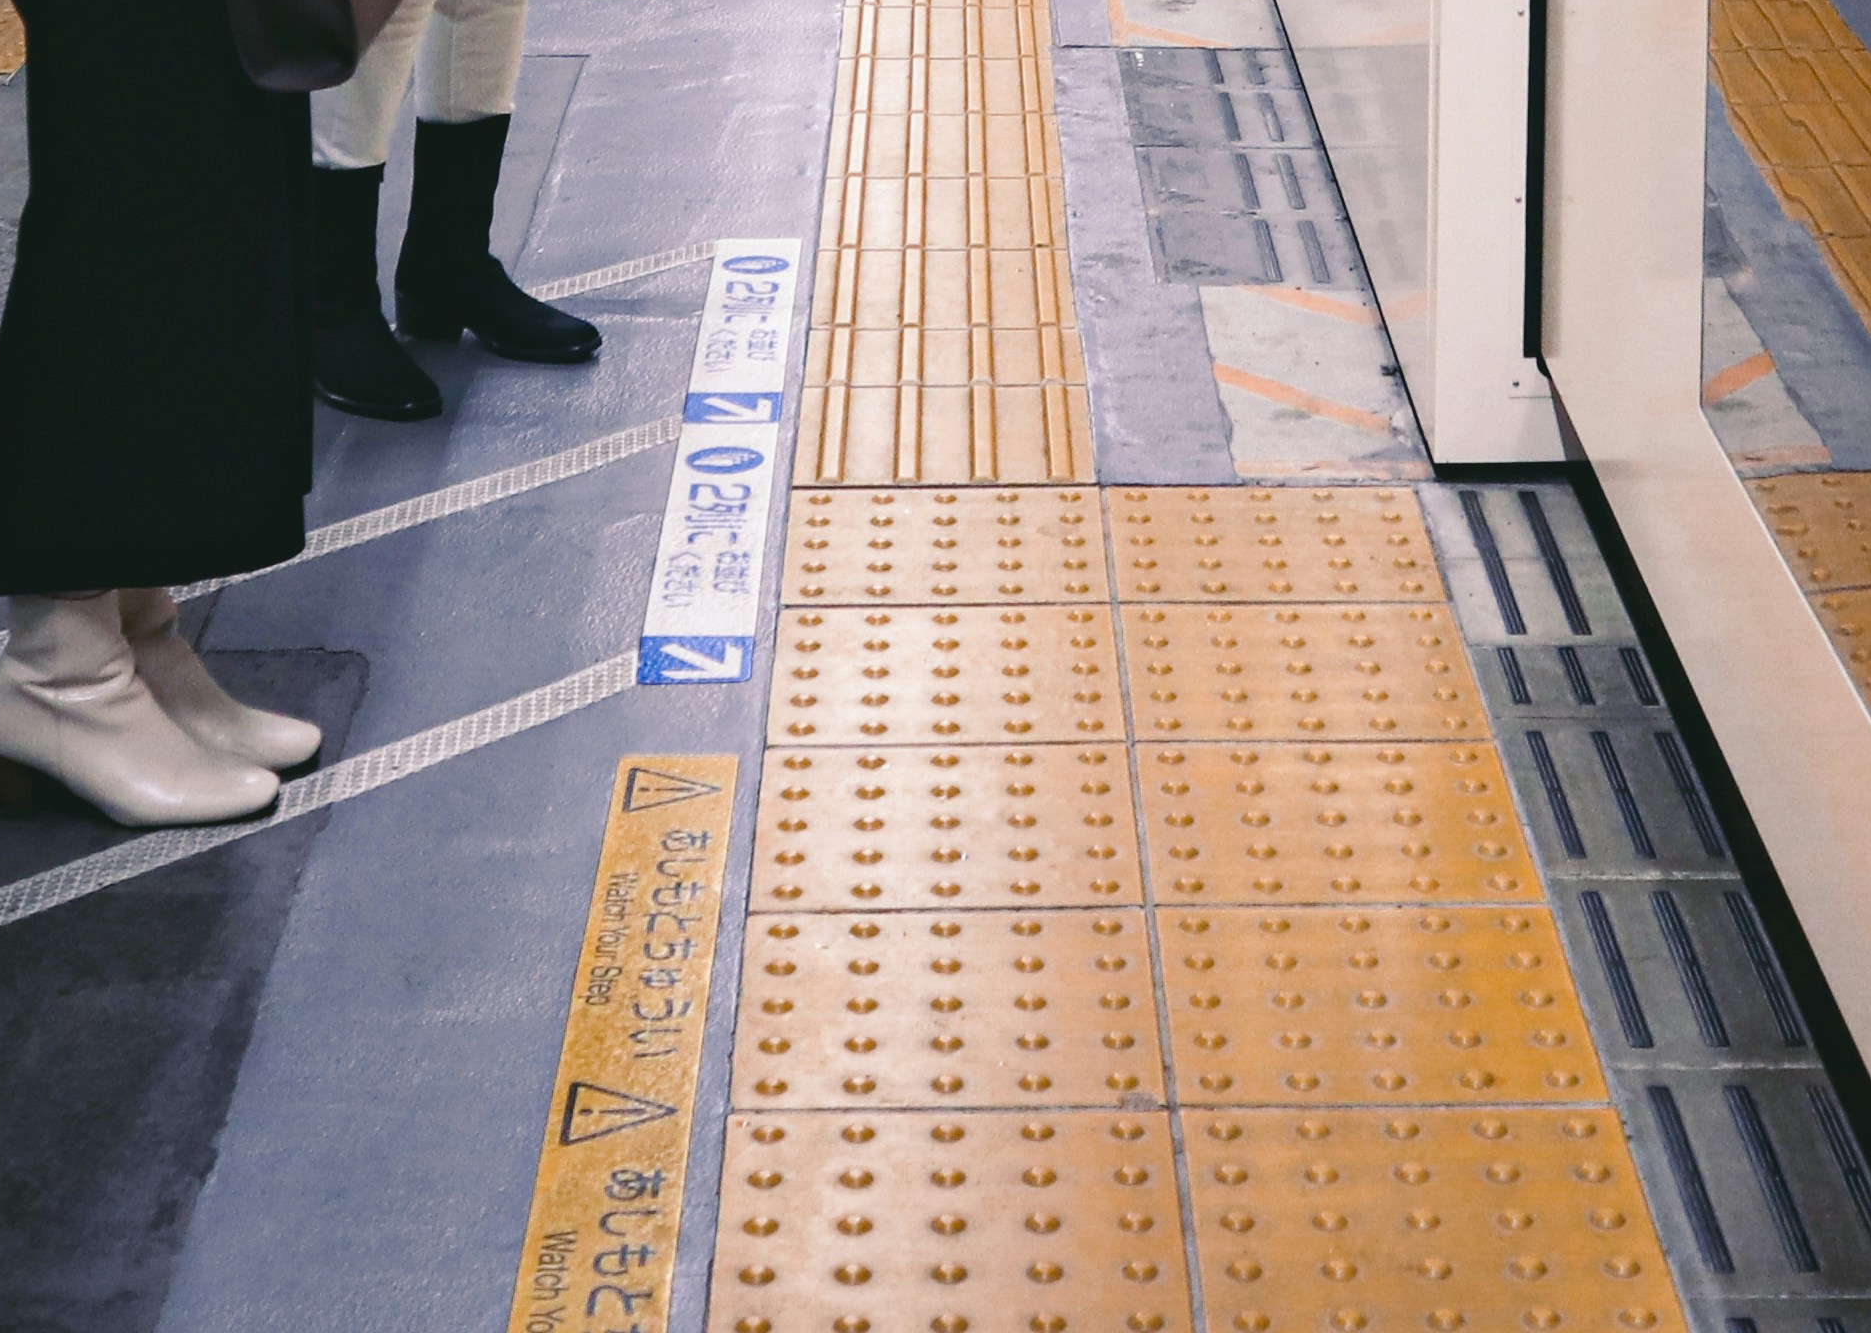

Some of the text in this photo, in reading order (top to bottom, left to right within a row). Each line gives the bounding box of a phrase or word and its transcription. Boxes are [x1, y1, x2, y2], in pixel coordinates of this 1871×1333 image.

[722, 281, 780, 323] 2列に
[703, 328, 738, 374] ください
[684, 483, 752, 544] 2列に
[662, 551, 703, 608] ください
[713, 551, 750, 594] お並び
[585, 871, 639, 1006] Watch Your Step
[629, 829, 713, 1059] あしもとちゅうい
[583, 1168, 666, 1333] あしもと
[526, 1230, 578, 1333] Watch Yo
